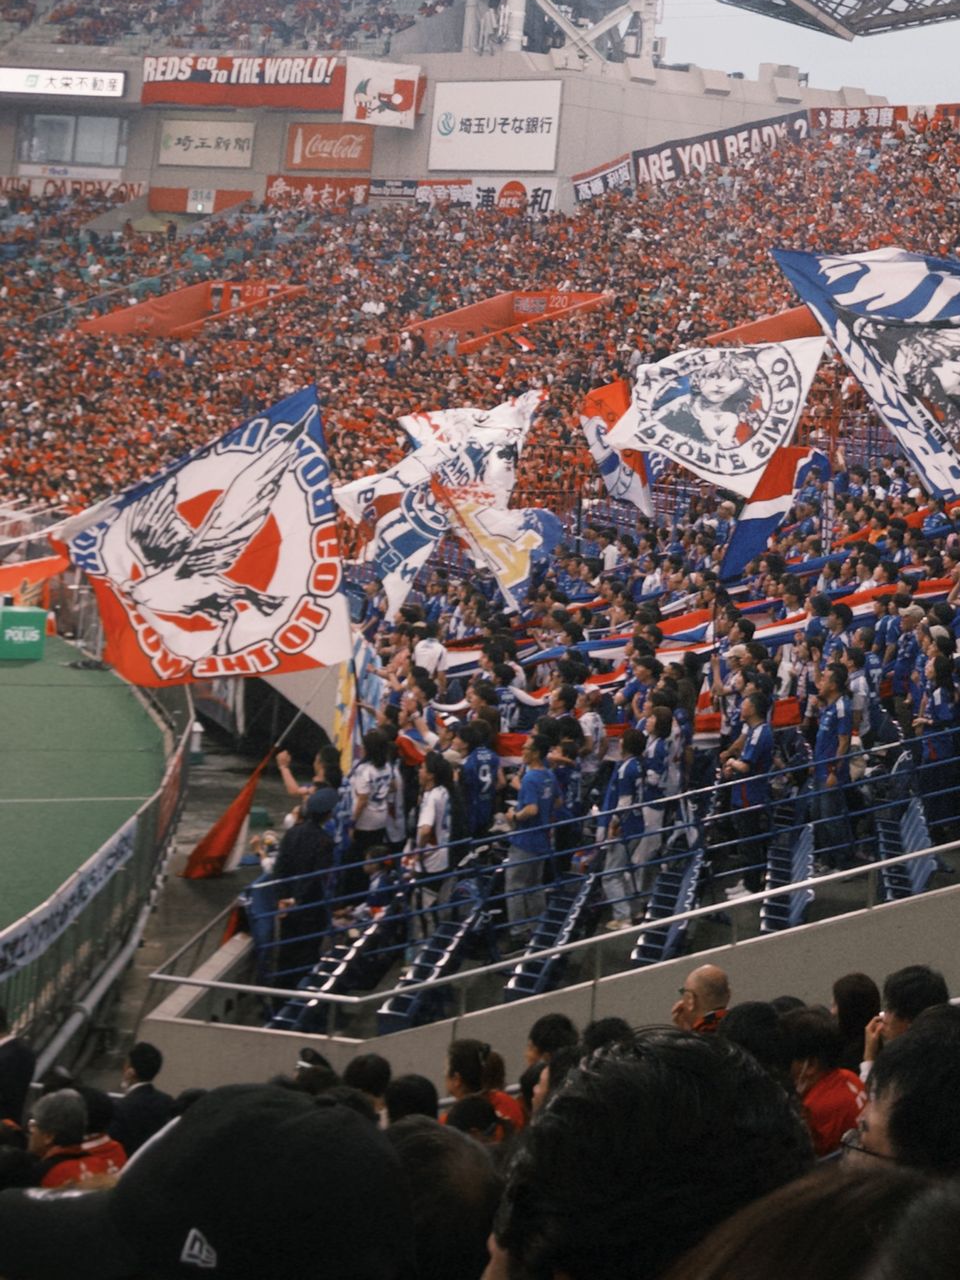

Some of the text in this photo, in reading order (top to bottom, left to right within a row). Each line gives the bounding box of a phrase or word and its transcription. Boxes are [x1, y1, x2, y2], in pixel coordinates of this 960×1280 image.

[143, 56, 338, 84] REDS GO TO THE WORLD!
[44, 76, 120, 92] 大栄不動産
[458, 116, 553, 135] 埼玉りそな銀行
[304, 133, 366, 159] Coca-Cola
[637, 147, 675, 186] ARE
[676, 137, 721, 175] YOU
[793, 118, 808, 140] ?
[192, 190, 212, 202] 314
[4, 628, 41, 641] POLUS
[478, 764, 493, 794] 9
